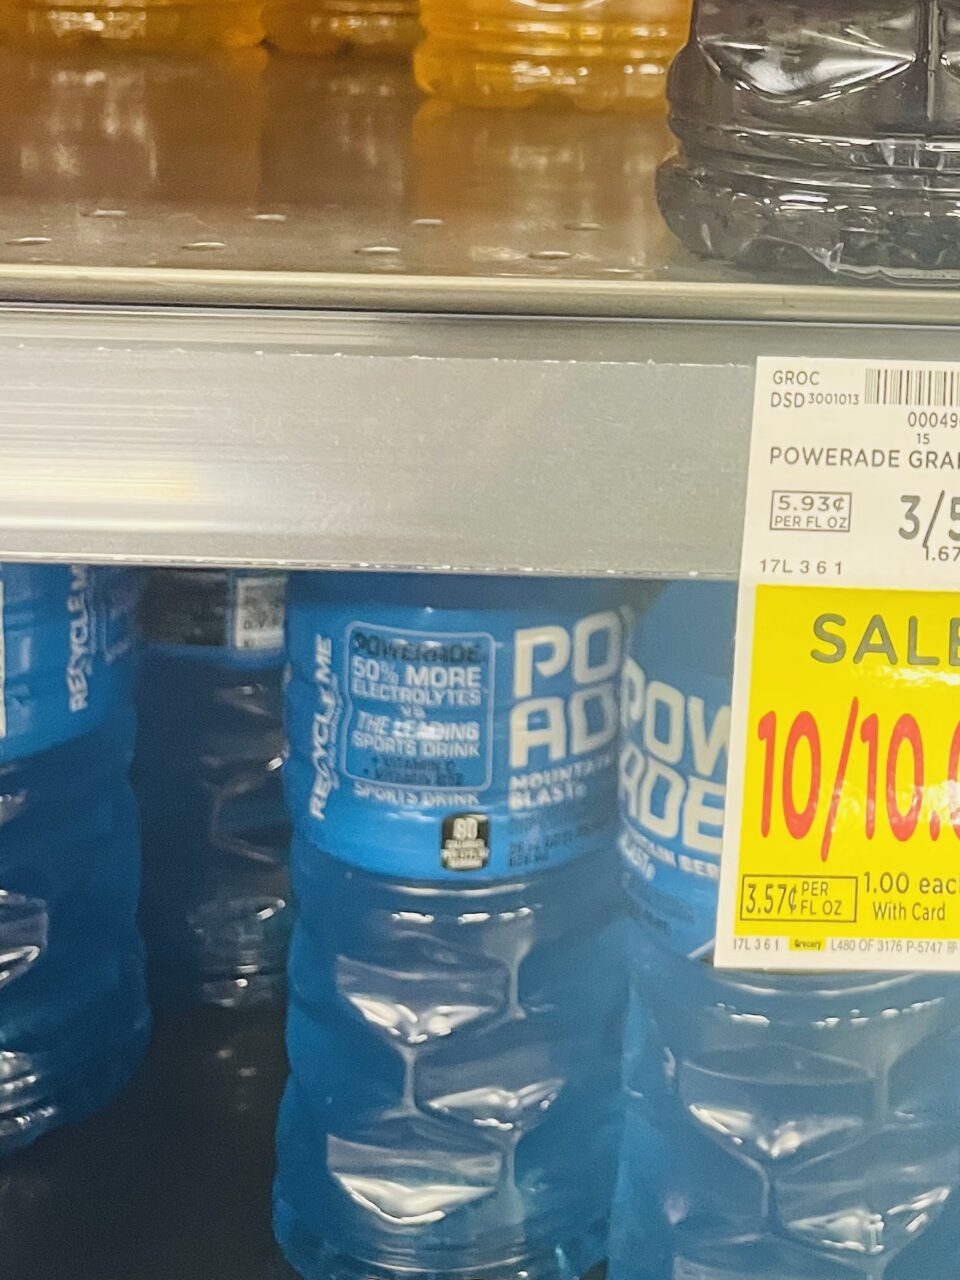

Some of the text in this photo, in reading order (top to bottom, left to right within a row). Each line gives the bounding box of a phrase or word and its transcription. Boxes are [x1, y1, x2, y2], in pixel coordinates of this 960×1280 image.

[772, 370, 820, 386] GROC
[770, 392, 860, 408] DSD 3001013
[916, 433, 931, 445] 15
[769, 446, 901, 468] POWERADE
[777, 495, 845, 512] 5.93¢
[774, 516, 848, 529] PER FL OZ
[760, 559, 793, 574] 17L
[405, 664, 482, 689] MORE
[352, 679, 481, 706] ELECTROLYTES
[359, 710, 390, 736] THE
[509, 684, 620, 769] AD
[621, 655, 732, 777] POW
[353, 730, 480, 759] SPORTS DRINK
[864, 871, 910, 895] 1.00
[746, 881, 829, 915] 3.57¢ PER
[801, 900, 842, 915] FL OZ
[873, 900, 907, 921] With
[911, 902, 946, 921] Card
[733, 938, 751, 950] 17L
[831, 939, 856, 952] L480
[858, 939, 874, 951] OF
